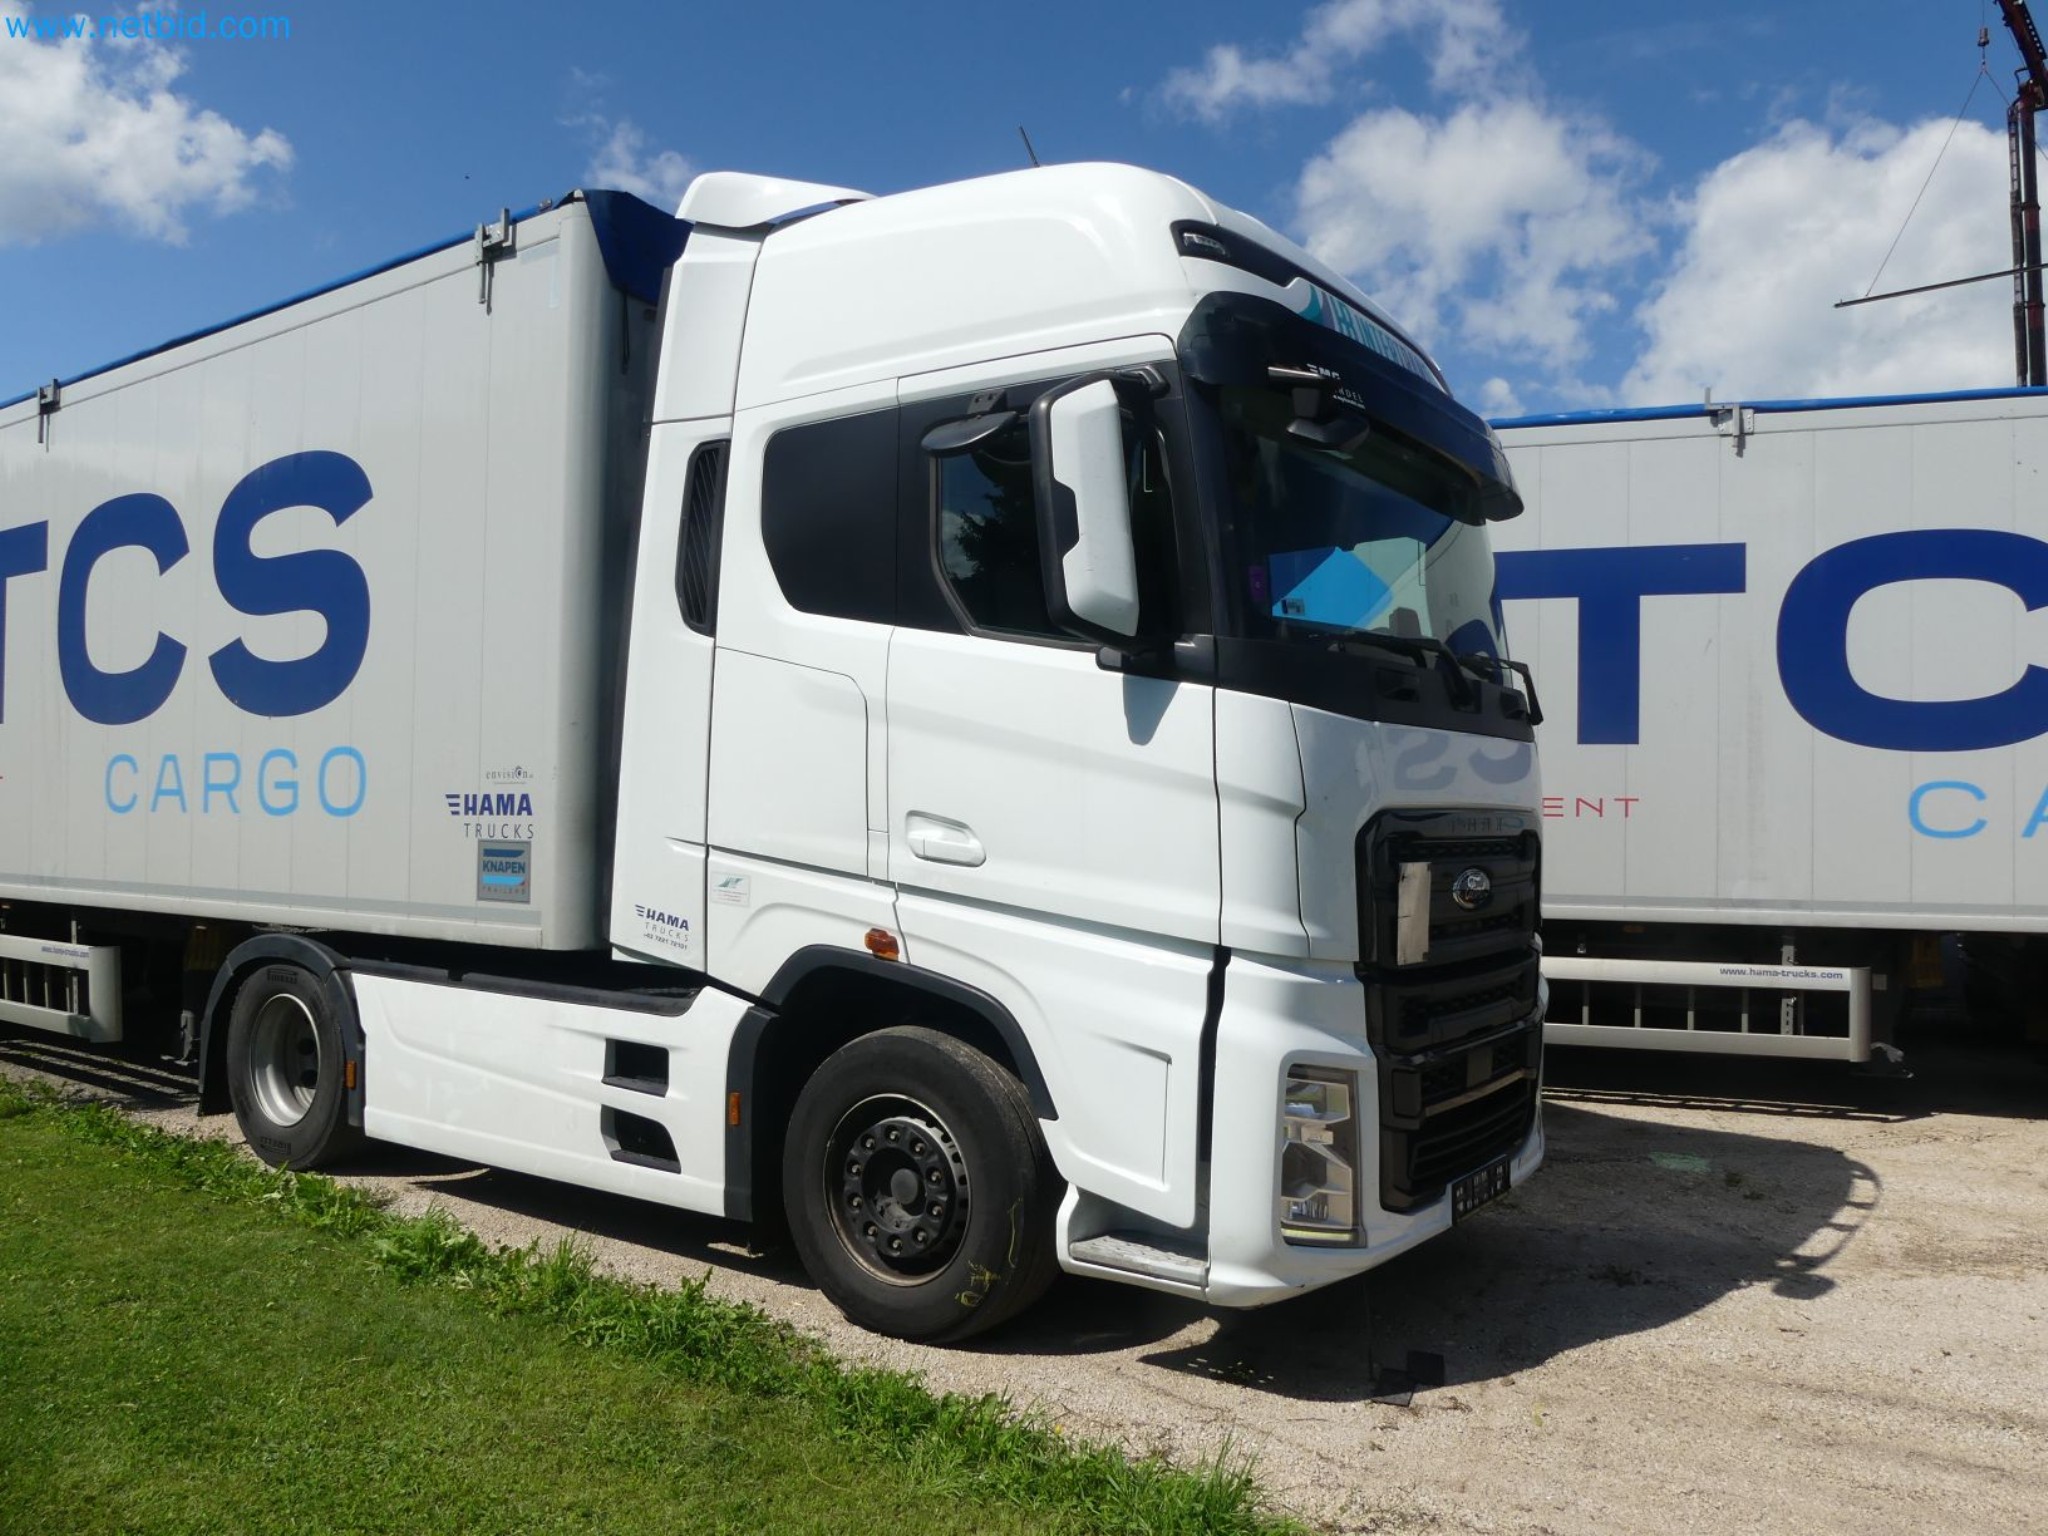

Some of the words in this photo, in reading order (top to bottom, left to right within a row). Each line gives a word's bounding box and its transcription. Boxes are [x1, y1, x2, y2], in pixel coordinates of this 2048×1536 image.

[0, 450, 374, 726] CS
[104, 746, 368, 818] CARGO
[464, 793, 533, 816] HAMA
[463, 822, 534, 839] TRUCKS
[482, 860, 526, 874] KNAPEN
[646, 907, 690, 932] HAMA
[645, 922, 689, 942] TRUCKS
[1719, 967, 1844, 980] www.hama-trucks.com
